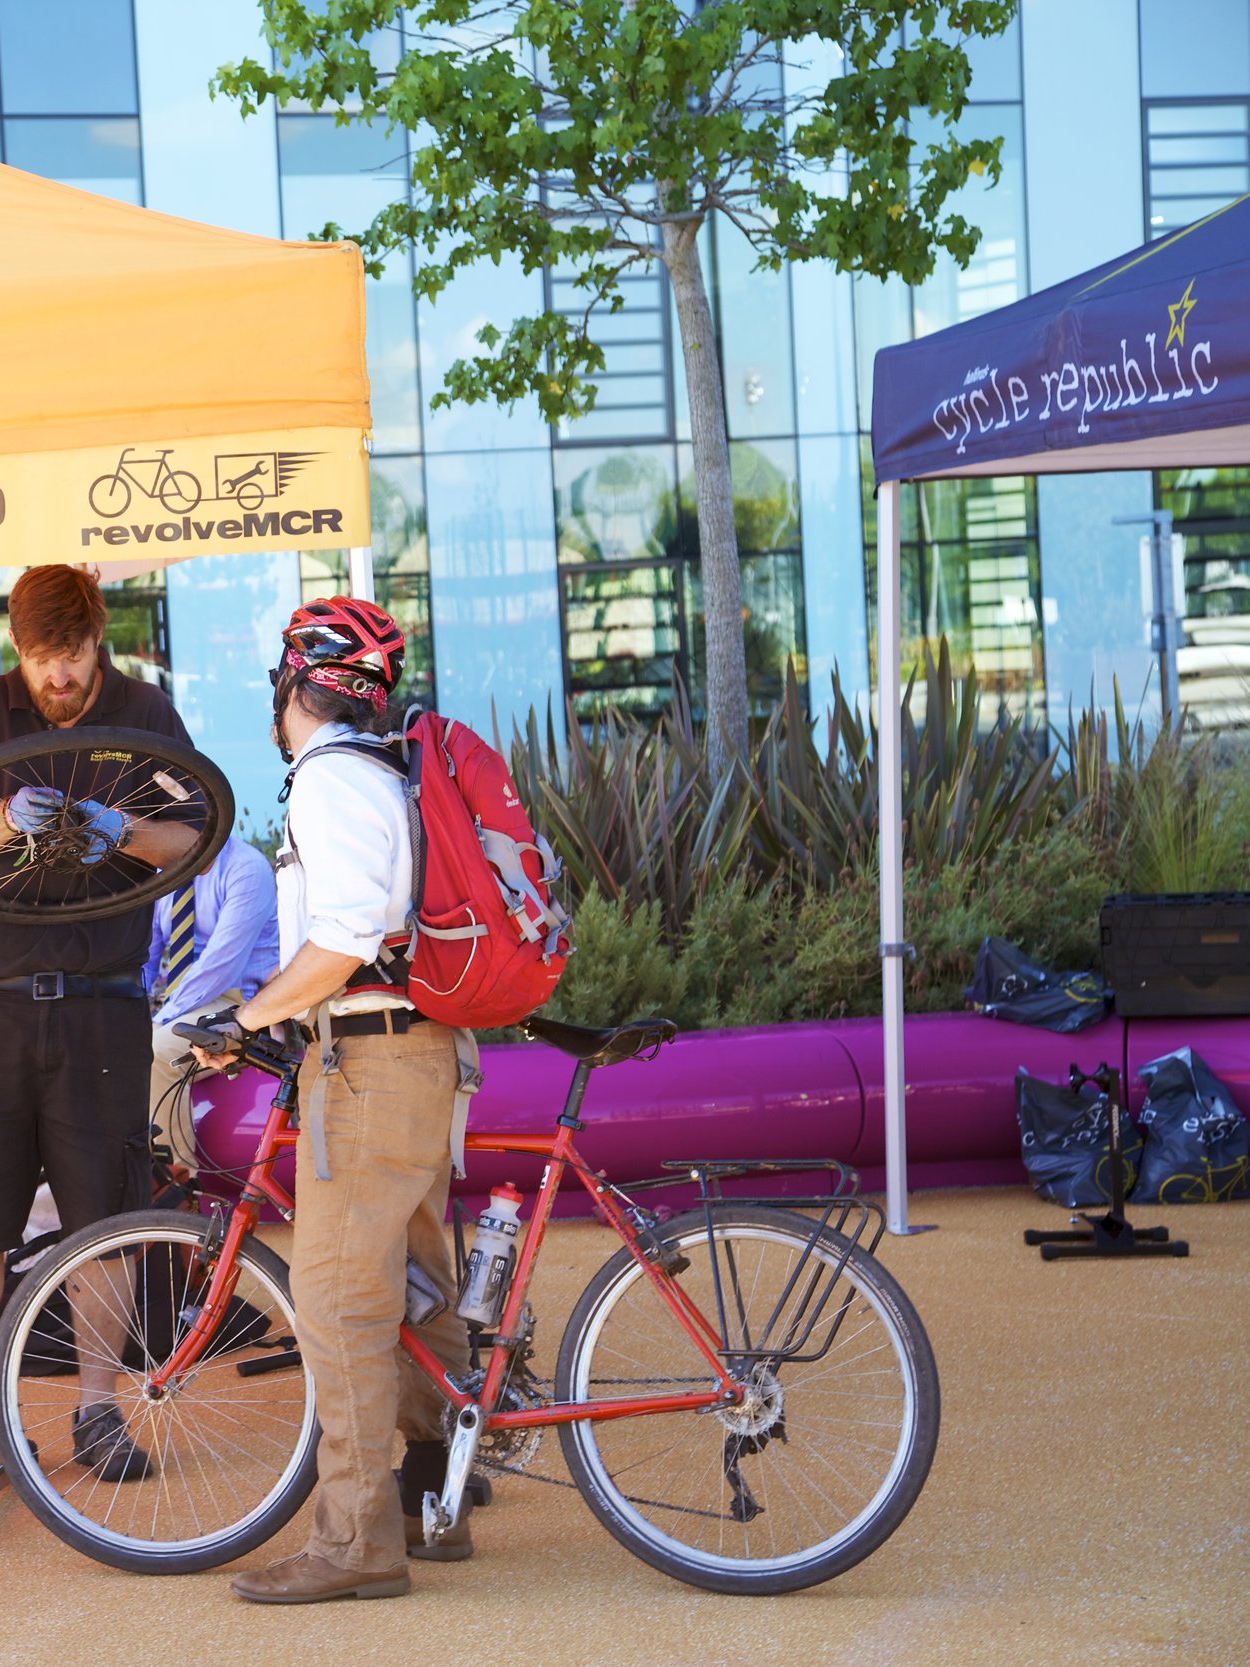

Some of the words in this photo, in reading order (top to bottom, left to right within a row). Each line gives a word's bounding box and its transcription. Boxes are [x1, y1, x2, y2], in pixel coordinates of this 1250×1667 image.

[932, 368, 1030, 455] cycle
[1038, 333, 1219, 434] republic
[80, 508, 343, 547] revolveMCR
